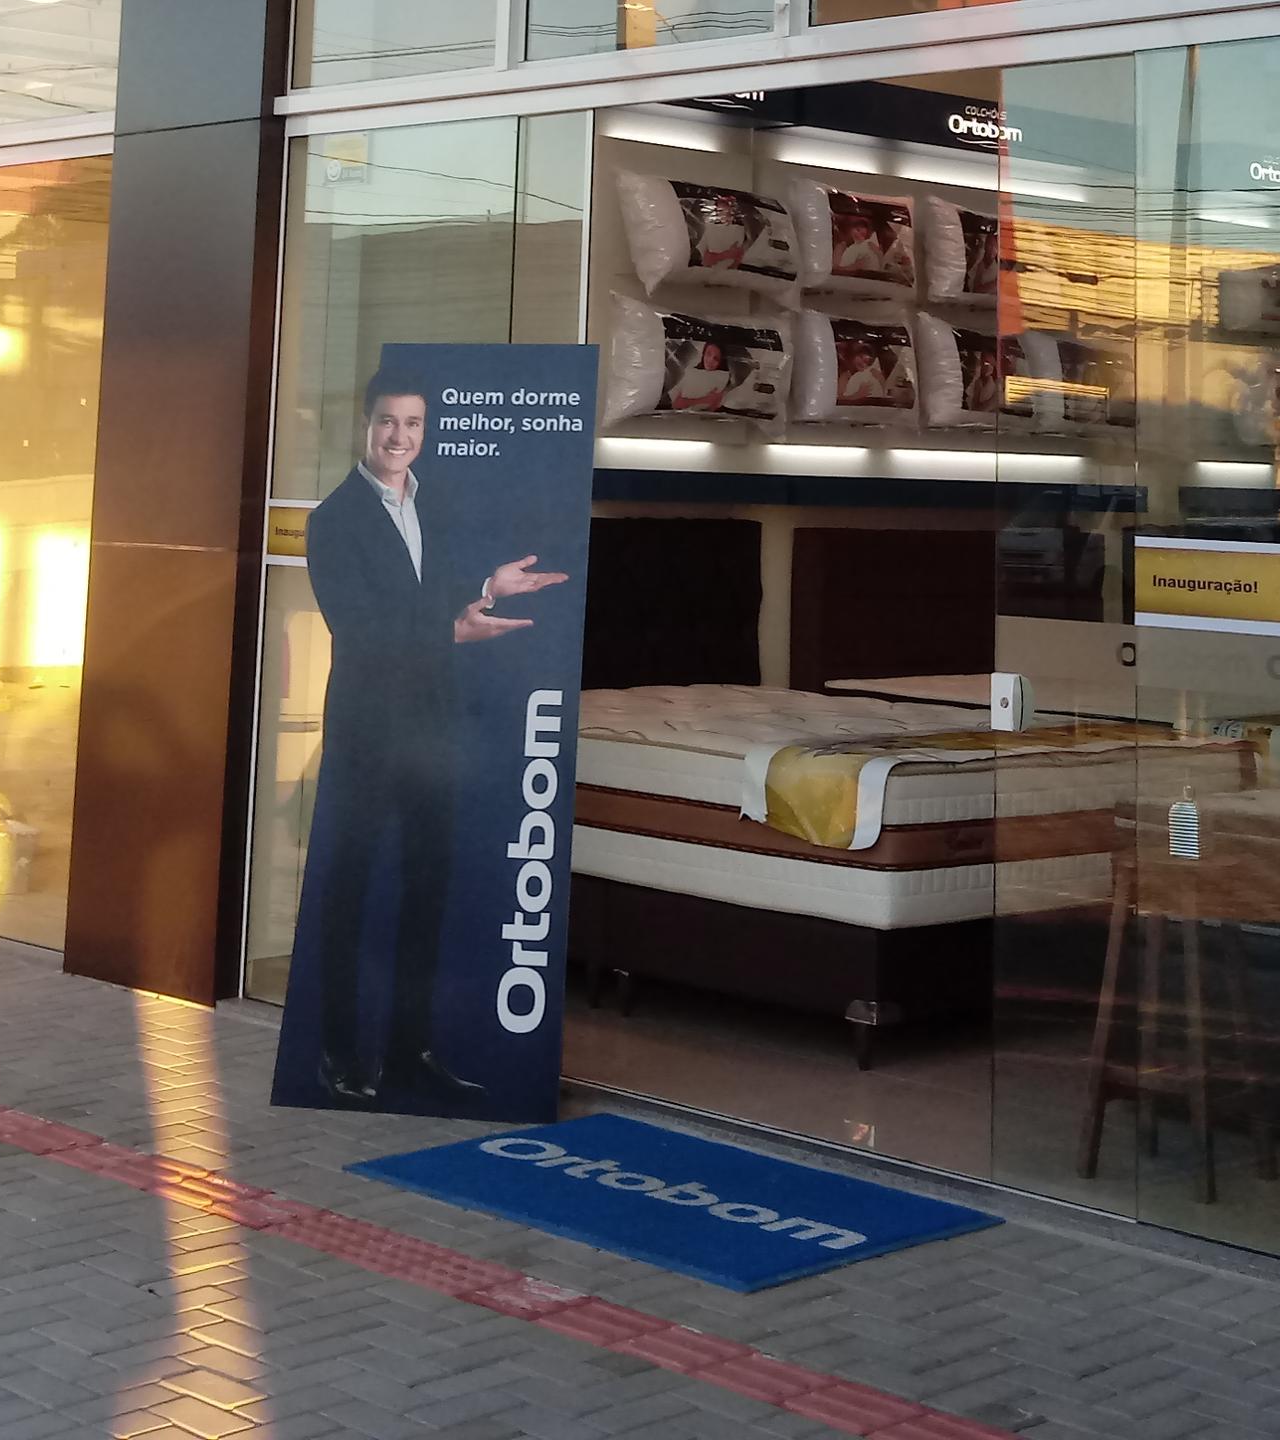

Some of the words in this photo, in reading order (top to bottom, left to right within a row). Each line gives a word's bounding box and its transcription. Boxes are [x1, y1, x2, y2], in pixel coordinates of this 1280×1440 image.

[948, 114, 1022, 142] Ortobom
[441, 388, 504, 406] Quem
[511, 388, 581, 406] dorme
[439, 413, 515, 434] melhor,
[521, 415, 583, 432] sonha
[437, 439, 500, 456] maior.
[1152, 574, 1259, 596] Inauguração!
[496, 689, 564, 1034] Ortobom
[479, 1137, 867, 1250] Ortobom
